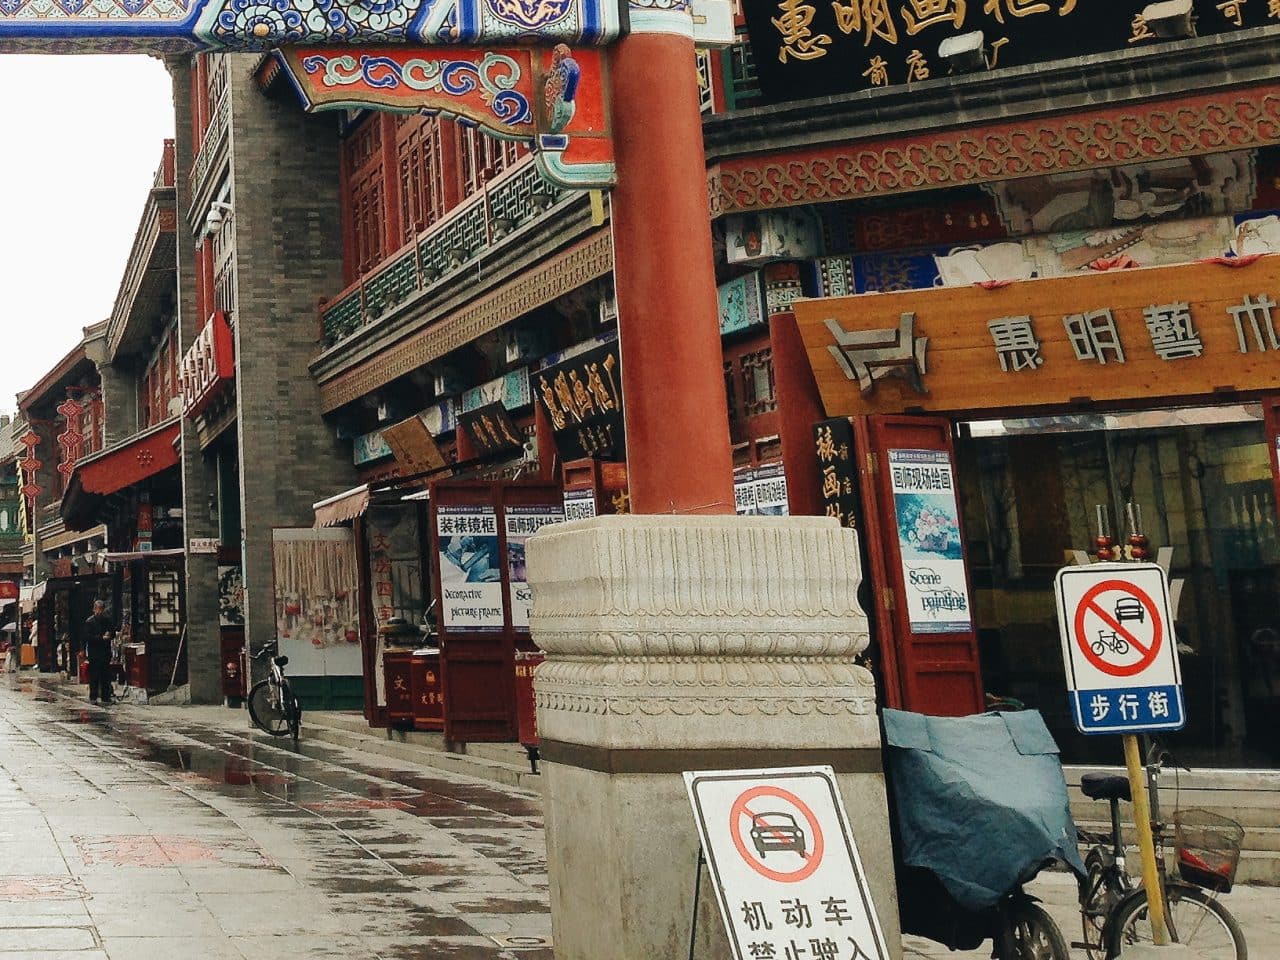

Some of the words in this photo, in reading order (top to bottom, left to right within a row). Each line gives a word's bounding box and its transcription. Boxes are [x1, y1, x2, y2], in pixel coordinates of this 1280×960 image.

[861, 36, 1011, 89] 前店厂
[893, 466, 952, 490] 画师现场绘画
[439, 516, 496, 534] 装裱镜框
[909, 570, 942, 586] Scene
[921, 592, 967, 613] painting
[1089, 689, 1170, 722] 步行街
[740, 895, 853, 932] 机动车
